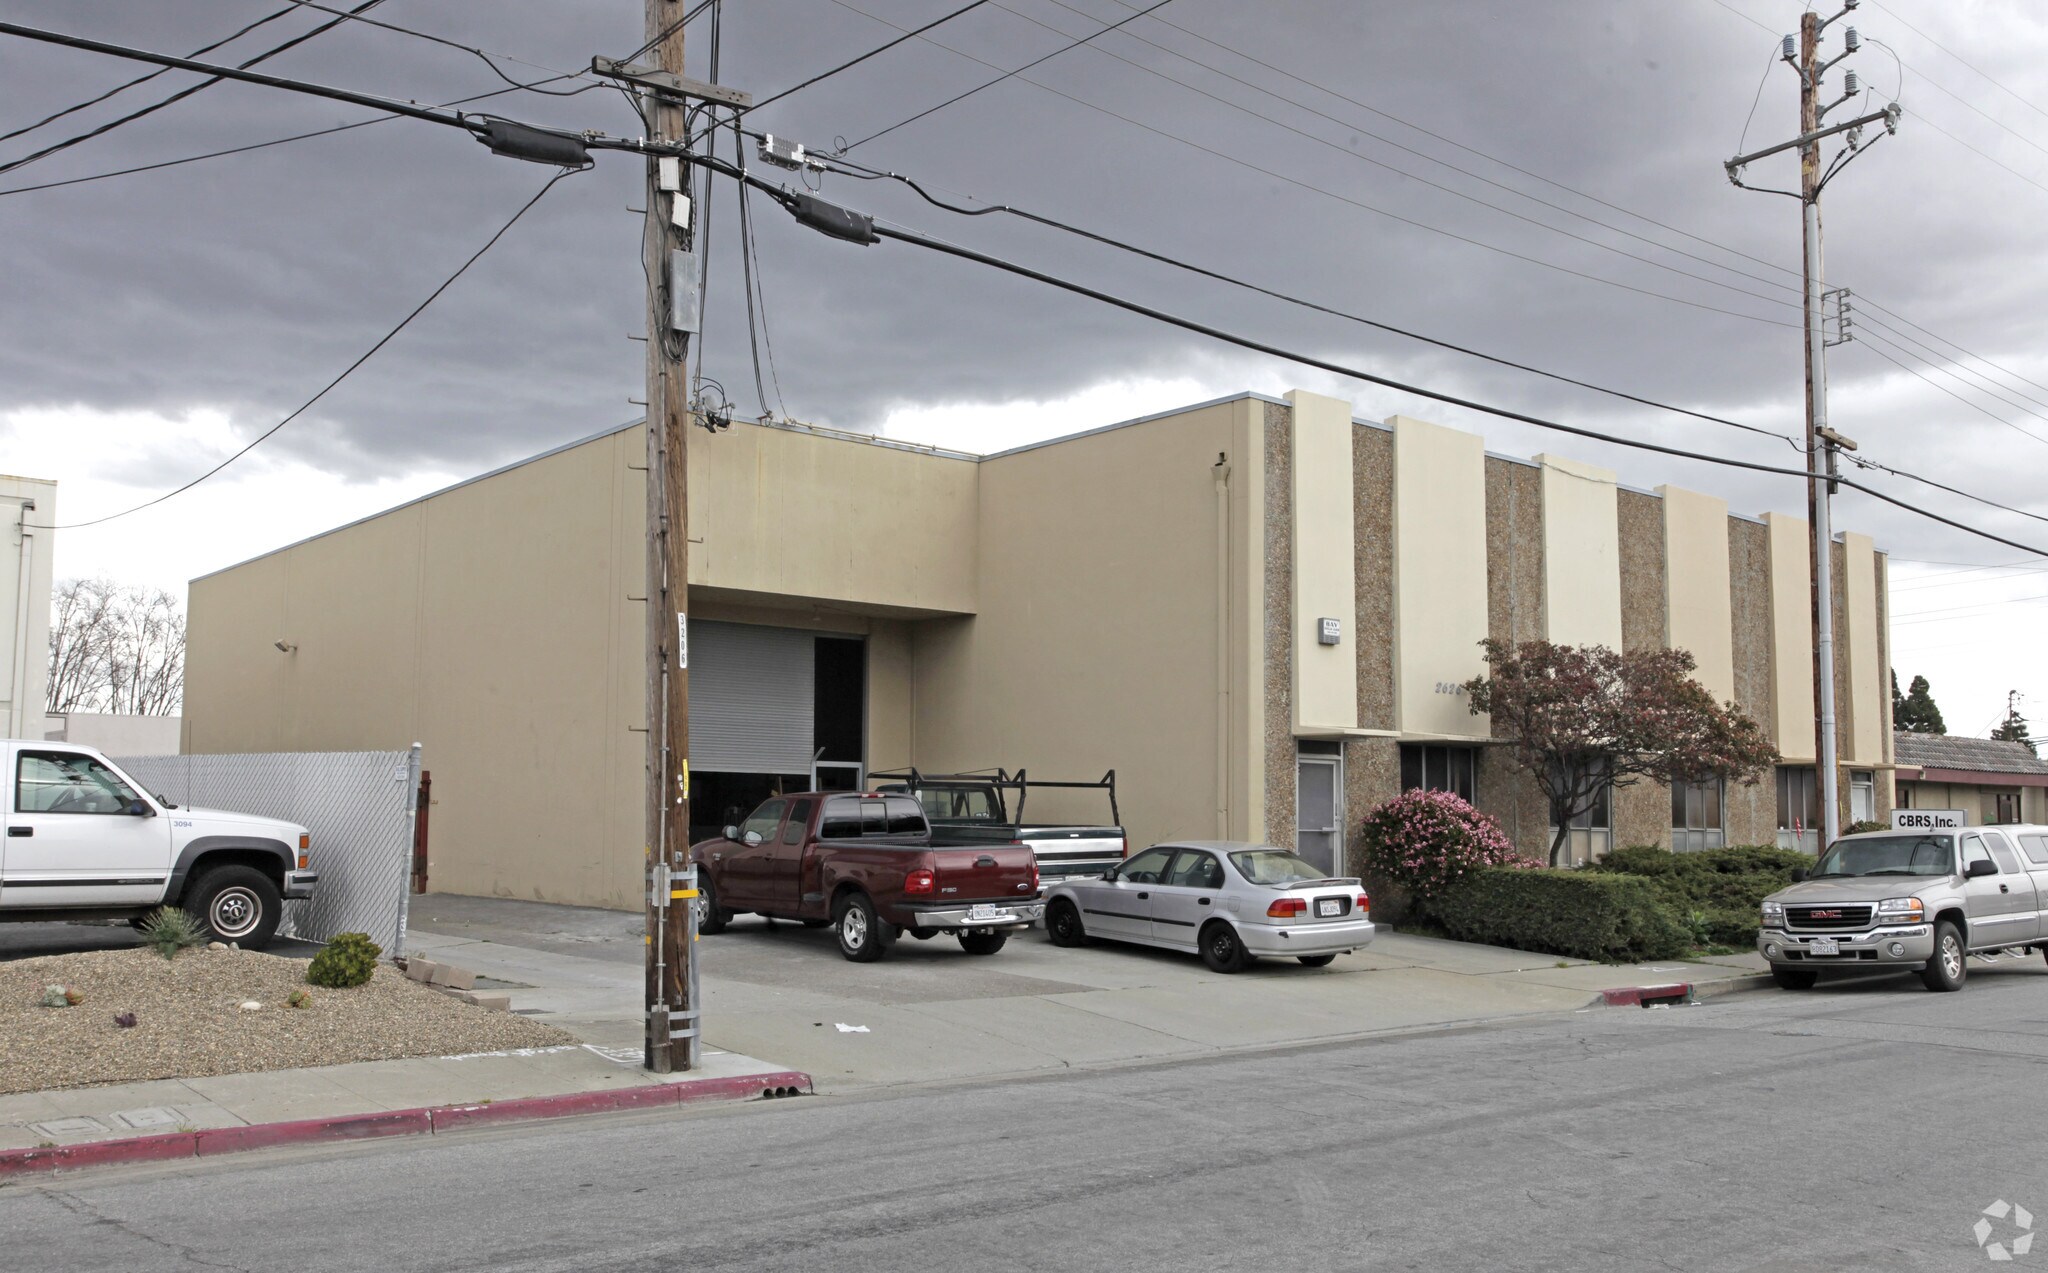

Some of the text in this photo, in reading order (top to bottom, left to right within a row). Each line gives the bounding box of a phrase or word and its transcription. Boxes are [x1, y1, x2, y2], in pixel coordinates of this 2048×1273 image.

[1434, 681, 1462, 696] 2626
[173, 820, 193, 828] 3094
[1810, 909, 1842, 919] GMC
